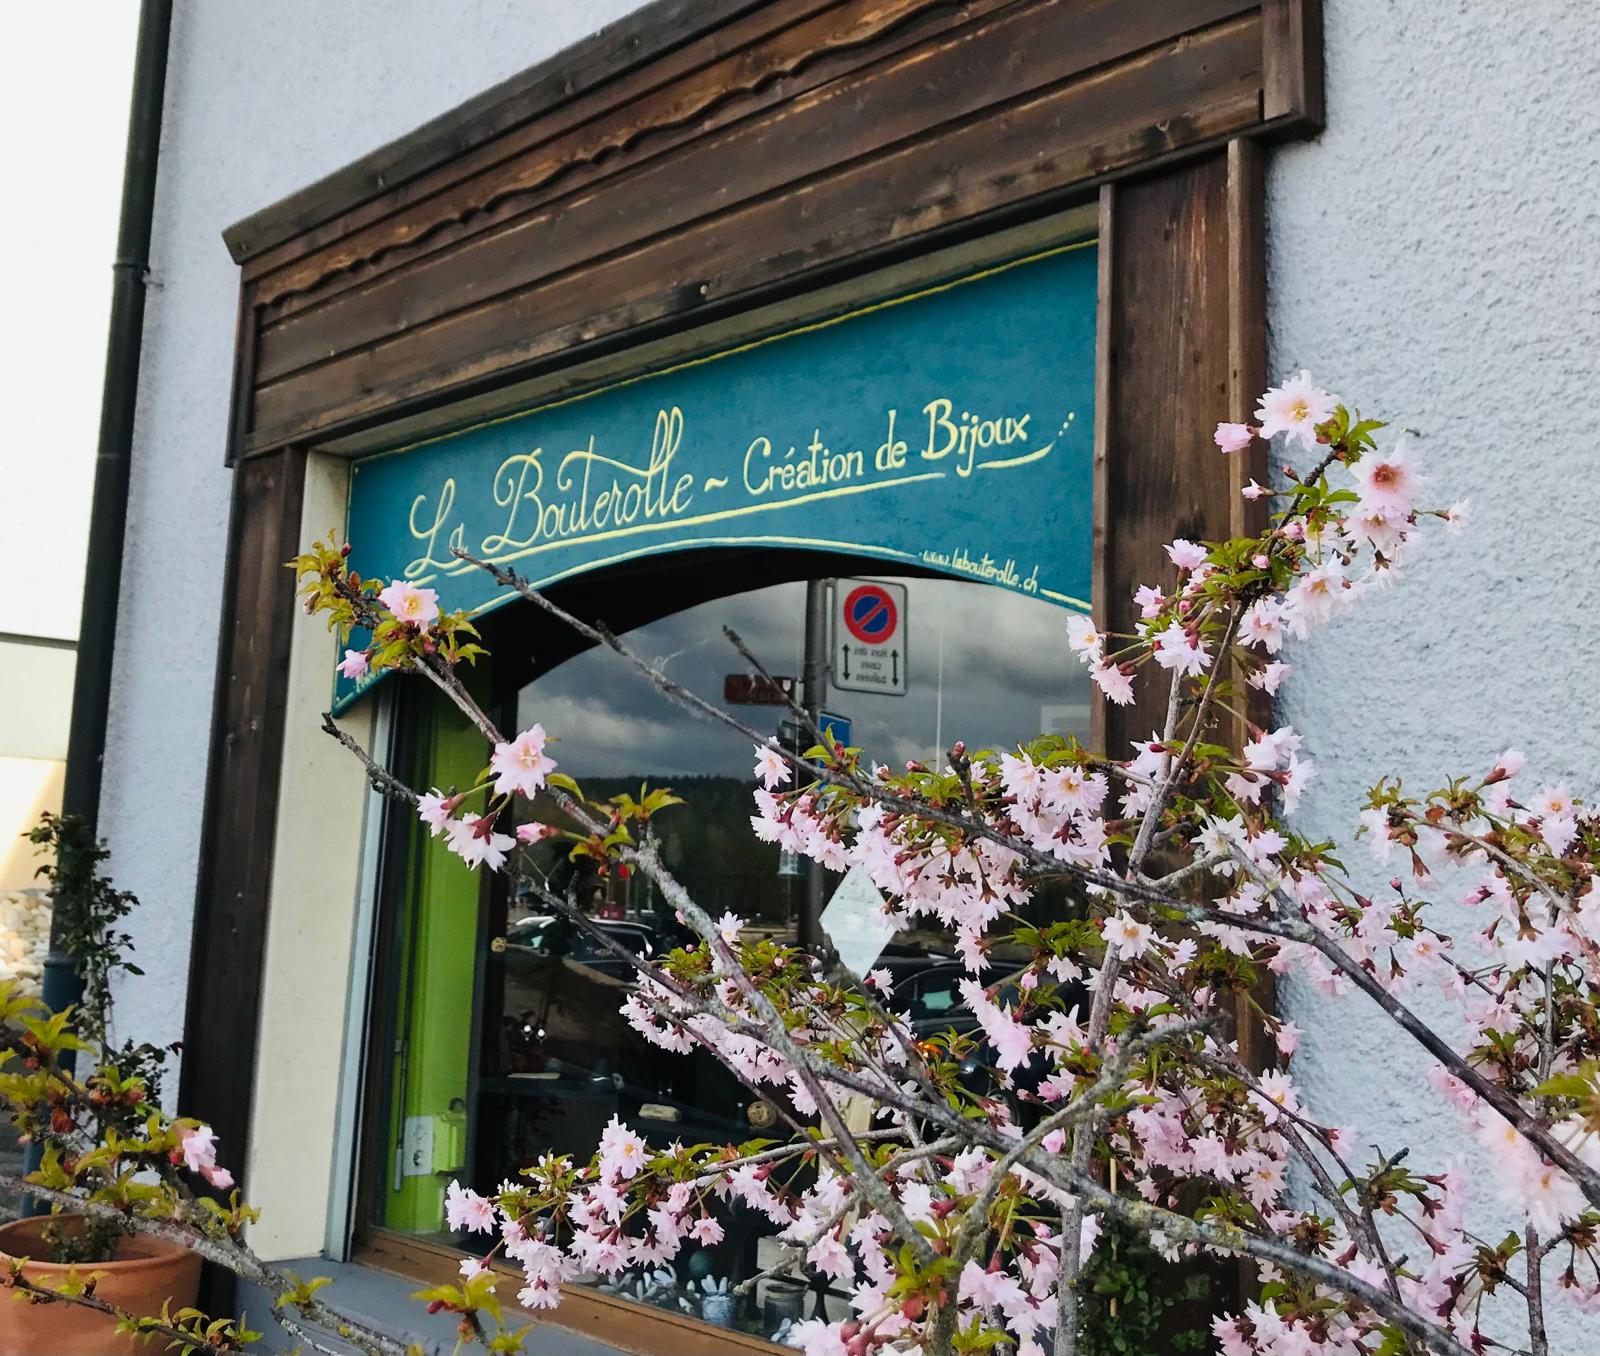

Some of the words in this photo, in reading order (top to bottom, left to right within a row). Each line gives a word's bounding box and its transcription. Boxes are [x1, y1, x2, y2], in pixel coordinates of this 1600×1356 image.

[404, 478, 469, 578] La
[481, 406, 694, 554] Bouterolle
[743, 428, 863, 495] Création
[874, 409, 907, 472] de
[920, 398, 1030, 477] Bijoux
